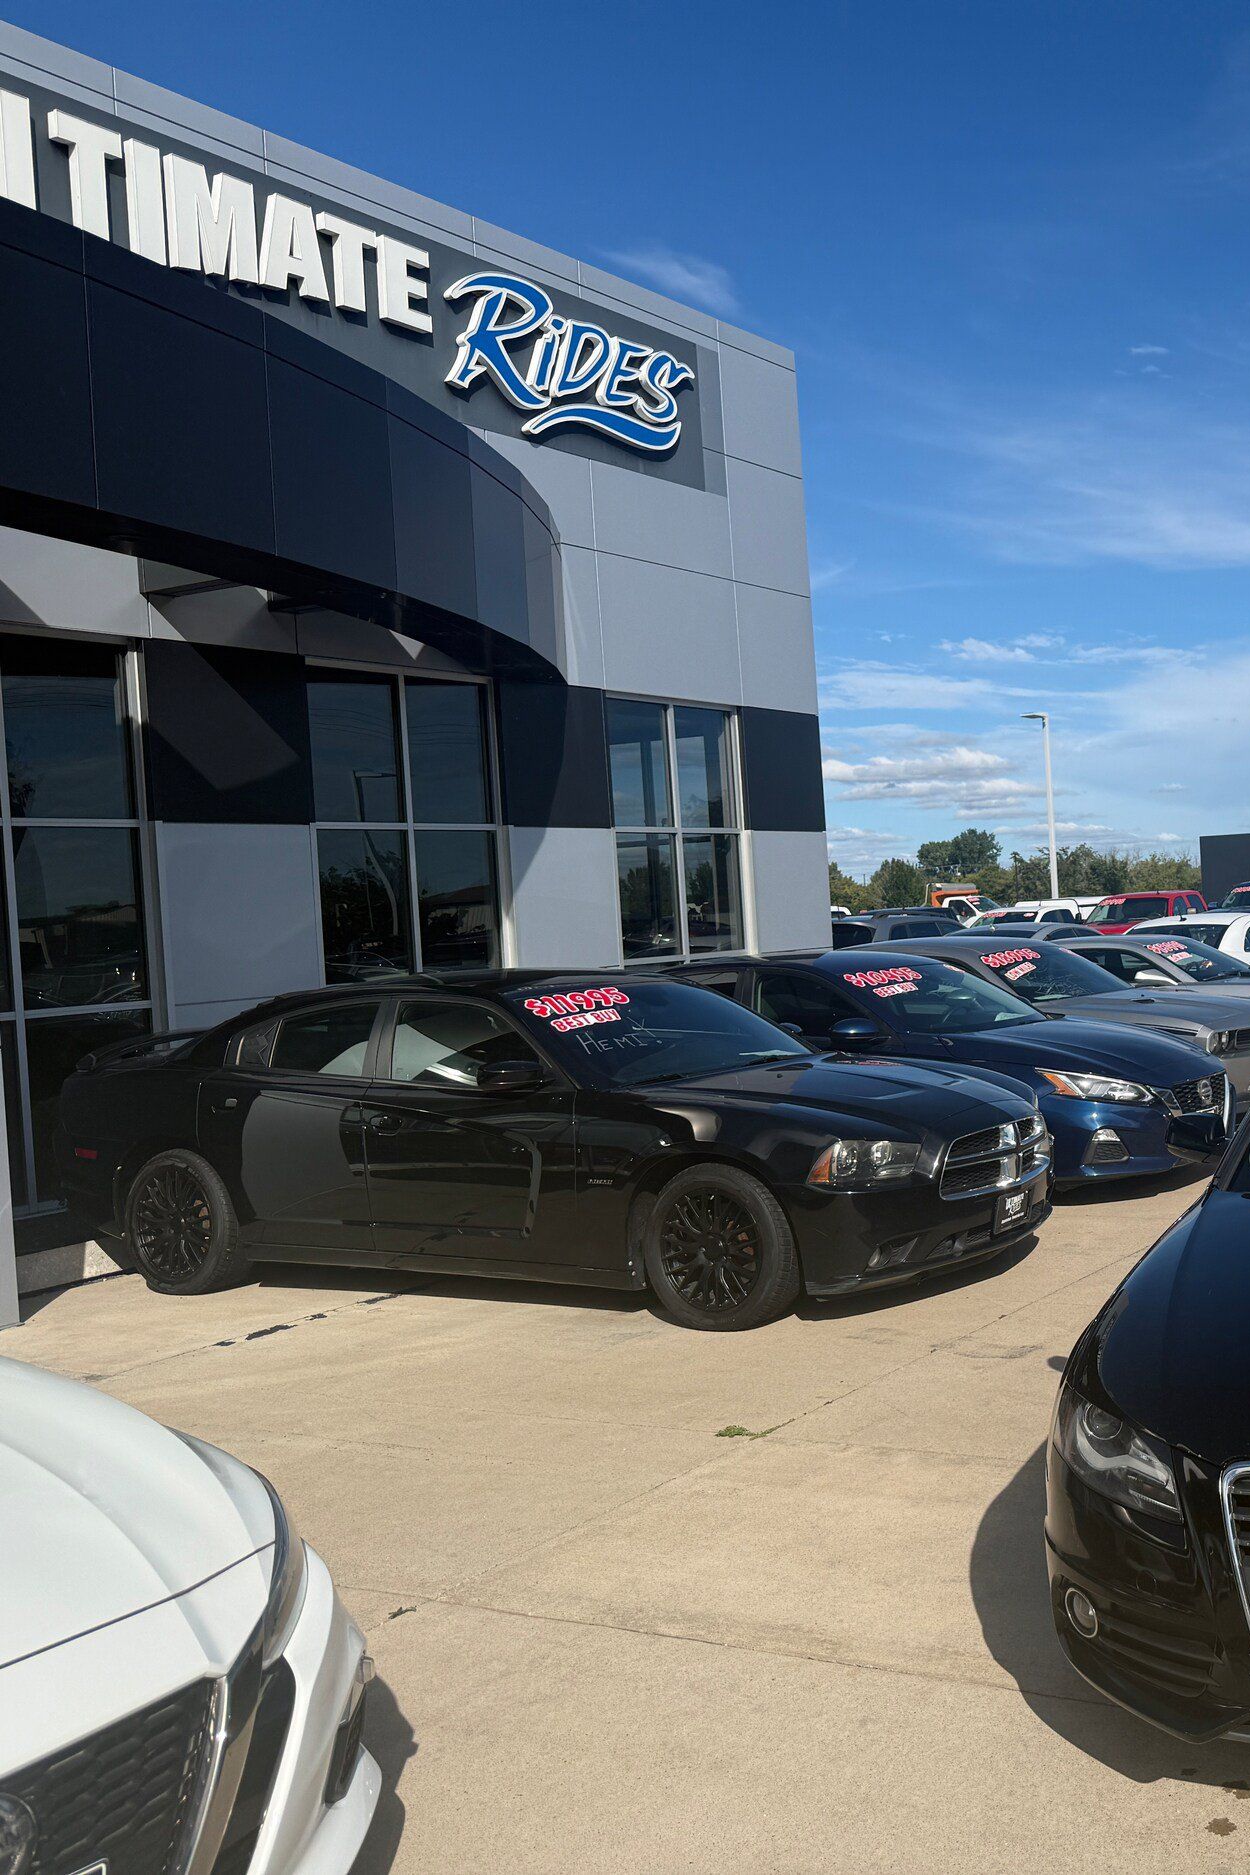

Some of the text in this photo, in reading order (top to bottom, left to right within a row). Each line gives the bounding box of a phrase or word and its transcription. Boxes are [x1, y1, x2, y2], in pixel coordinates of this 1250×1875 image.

[843, 966, 922, 987] $10495
[524, 987, 629, 1017] $11995
[872, 984, 899, 998] BEST
[551, 1009, 621, 1032] BEST BUY
